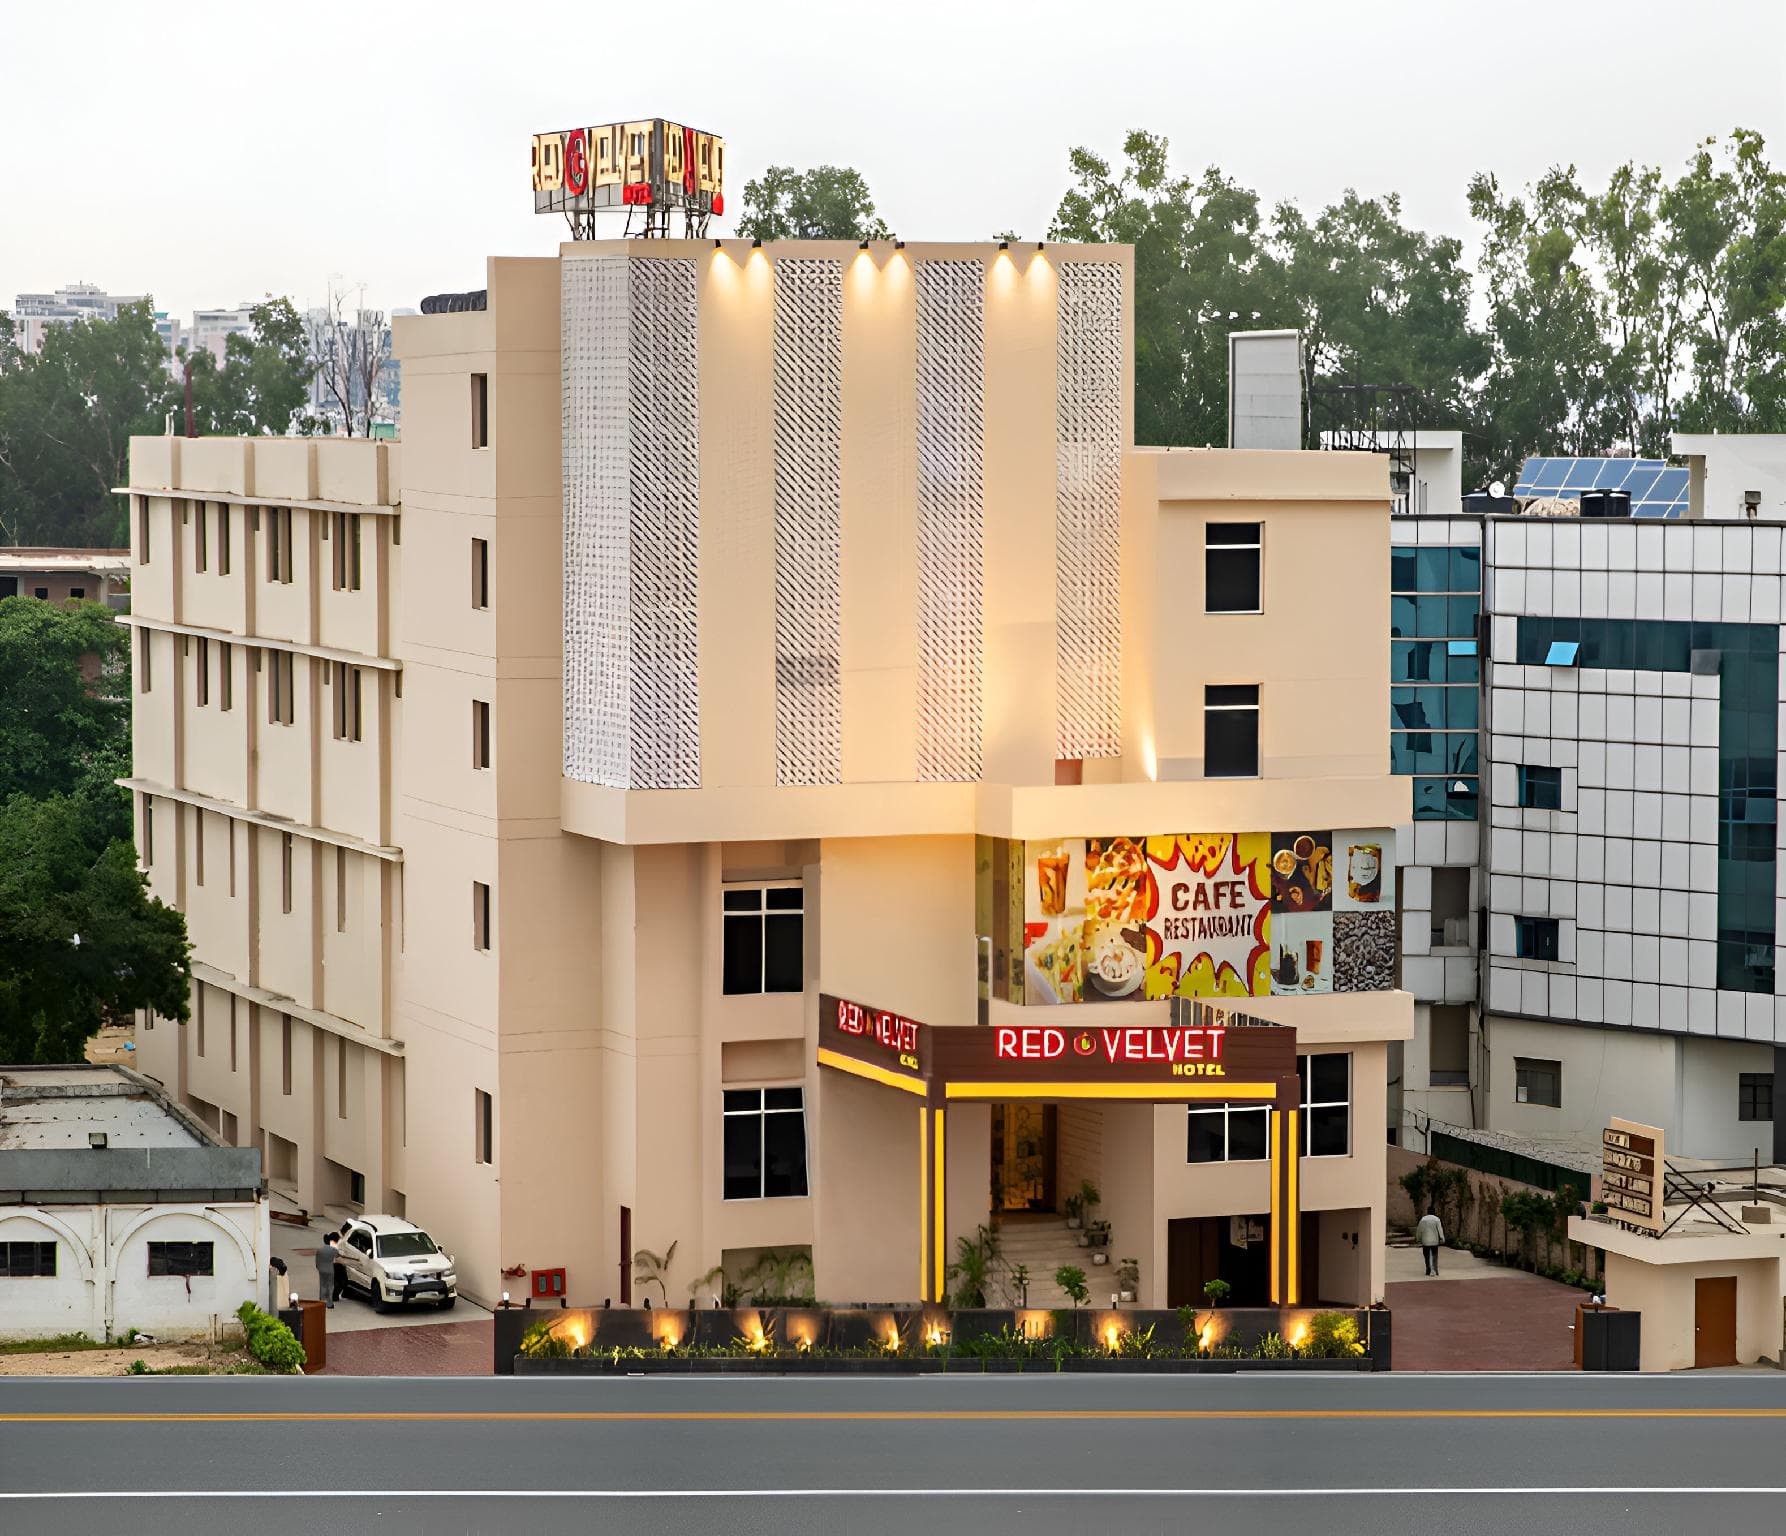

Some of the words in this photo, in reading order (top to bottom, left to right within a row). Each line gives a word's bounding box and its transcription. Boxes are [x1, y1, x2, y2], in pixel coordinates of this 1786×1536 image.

[1171, 880, 1246, 912] CAFE
[998, 1029, 1065, 1058] RED
[1103, 1029, 1226, 1062] VELVET
[1172, 1063, 1226, 1076] HOTEL
